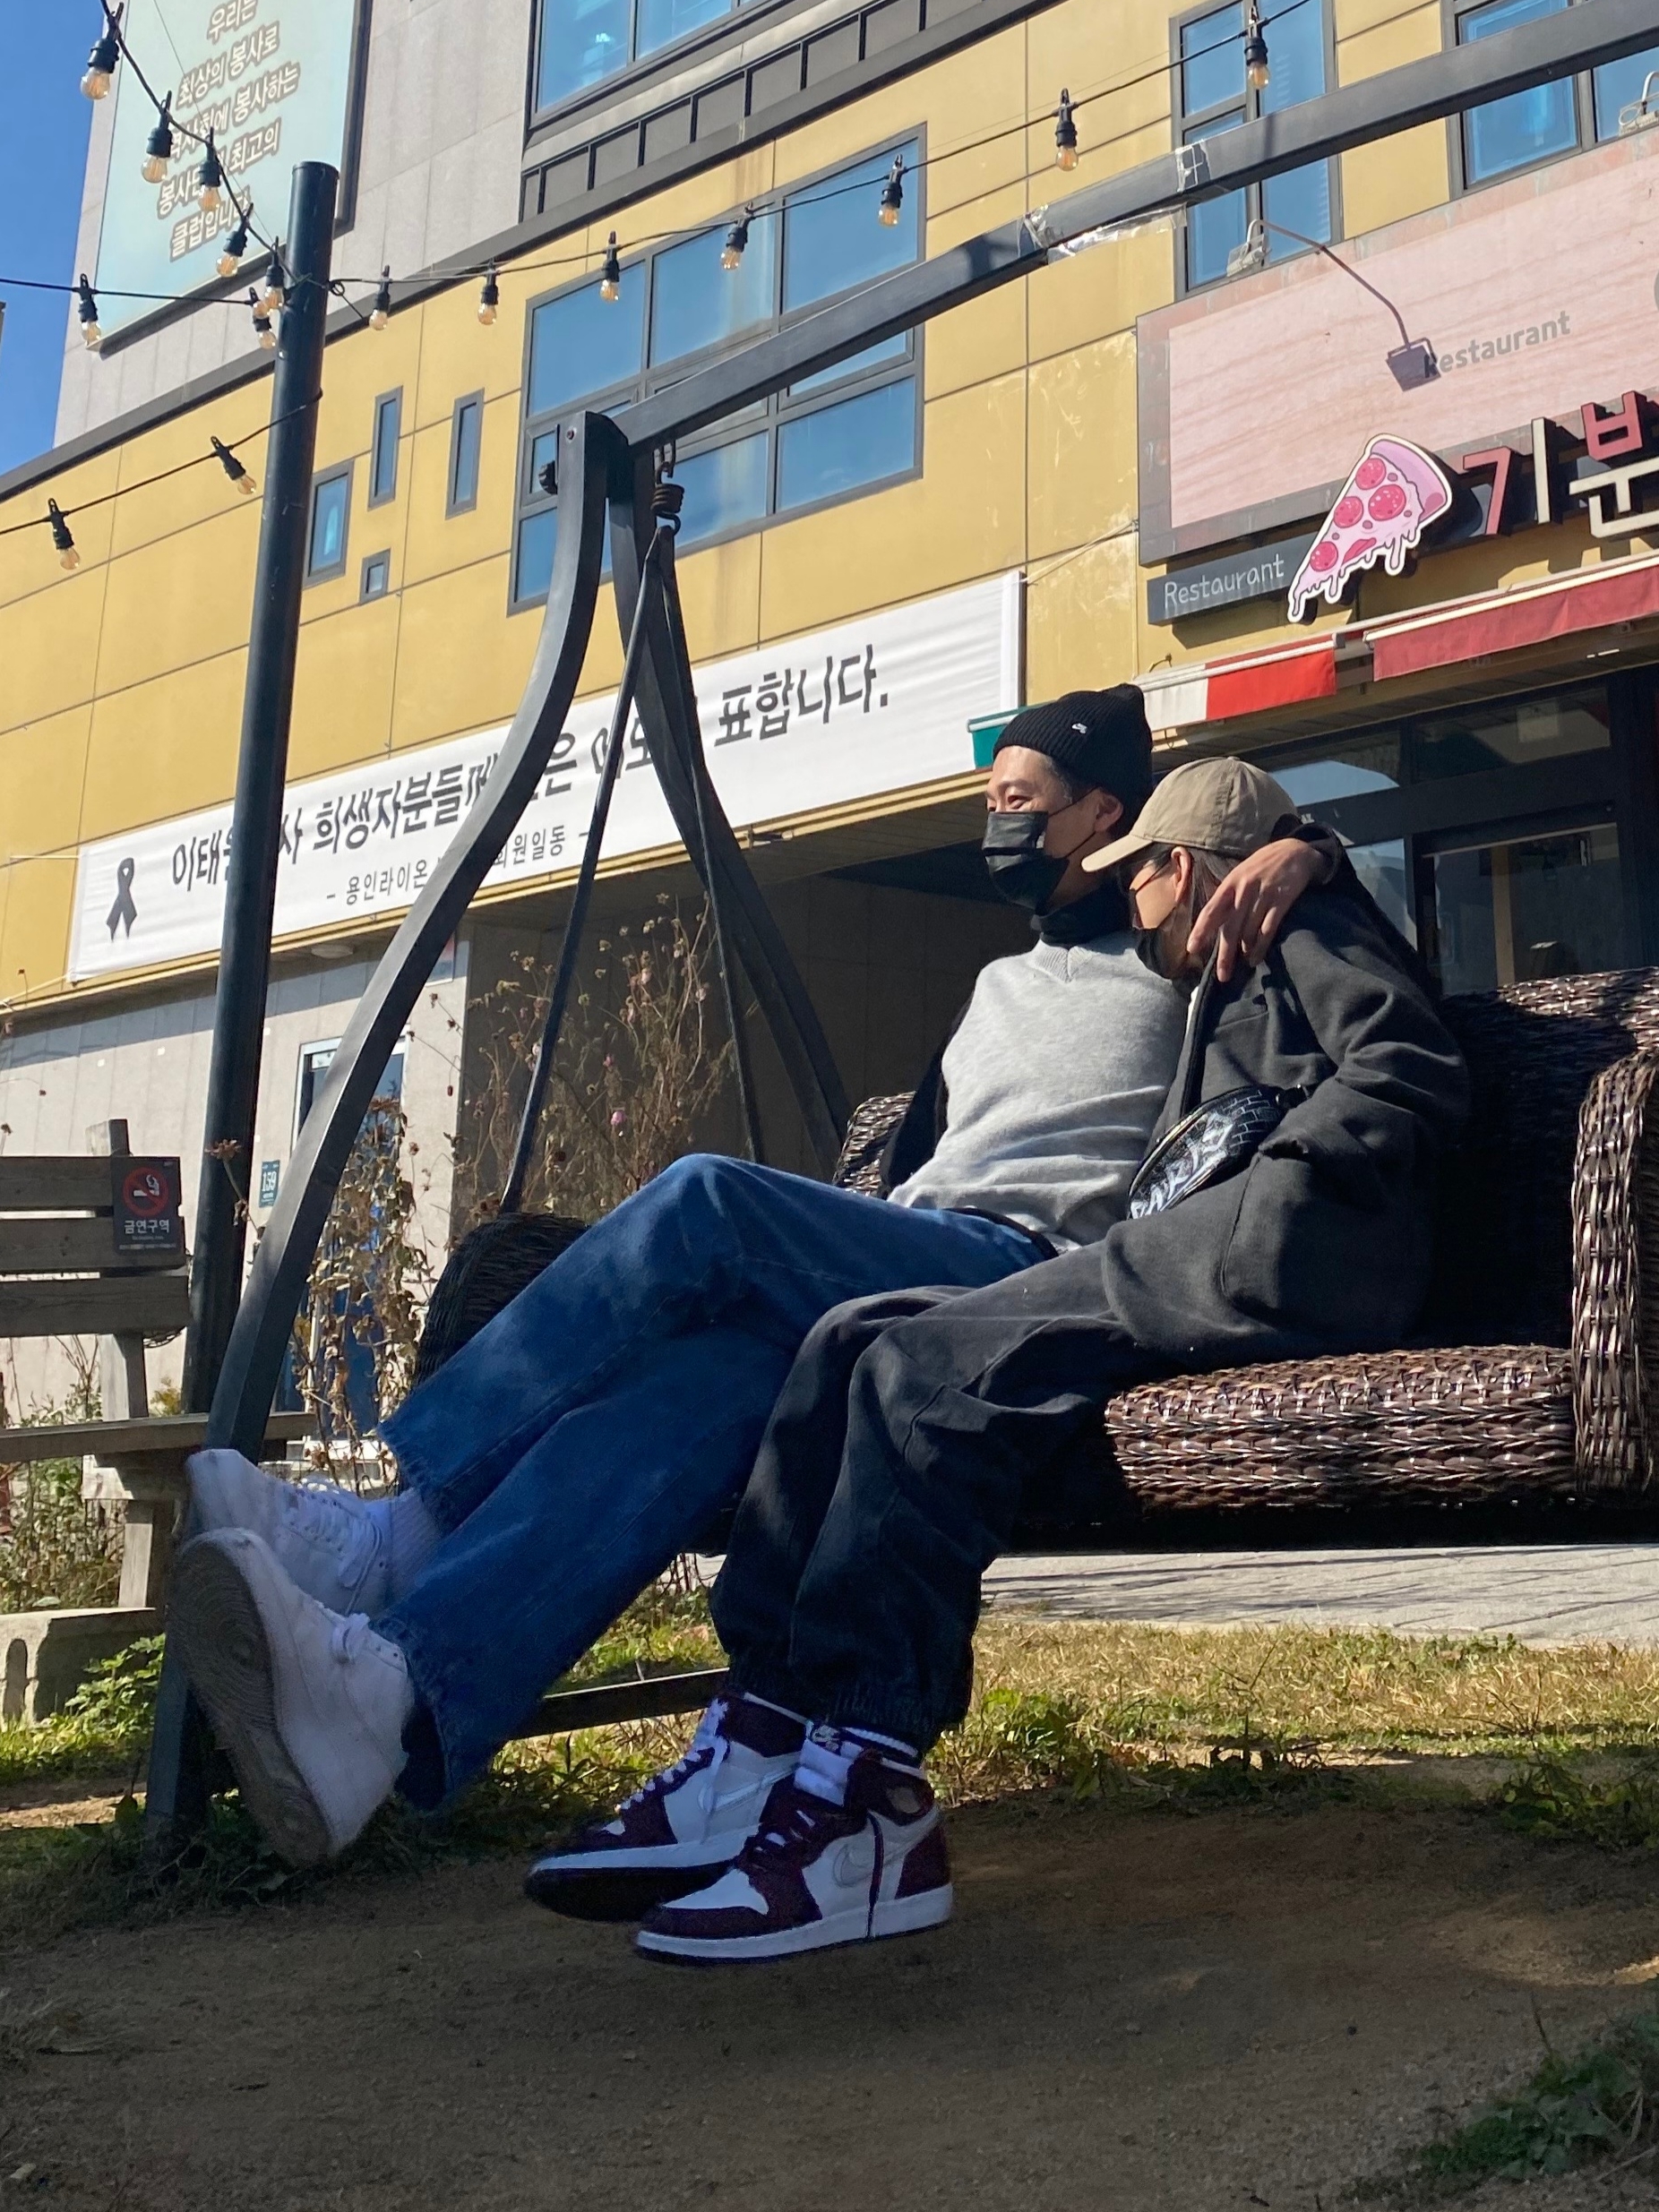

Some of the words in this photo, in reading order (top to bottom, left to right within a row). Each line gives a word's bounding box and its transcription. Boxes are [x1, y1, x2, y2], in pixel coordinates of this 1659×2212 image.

[208, 0, 257, 41] 우리는
[176, 55, 225, 106] 최상의
[228, 23, 279, 78] 봉사로
[169, 100, 229, 159] 역사회에
[233, 65, 299, 124] 봉사하는
[228, 121, 280, 172] 최고의
[170, 189, 250, 259] 클럽입니다
[1164, 553, 1285, 611] Restaurant
[279, 807, 304, 864] 사
[530, 732, 578, 802] 은
[714, 644, 888, 747] 표합니다.
[347, 856, 441, 905] 용인라이온
[124, 1219, 170, 1235] 금연구역
